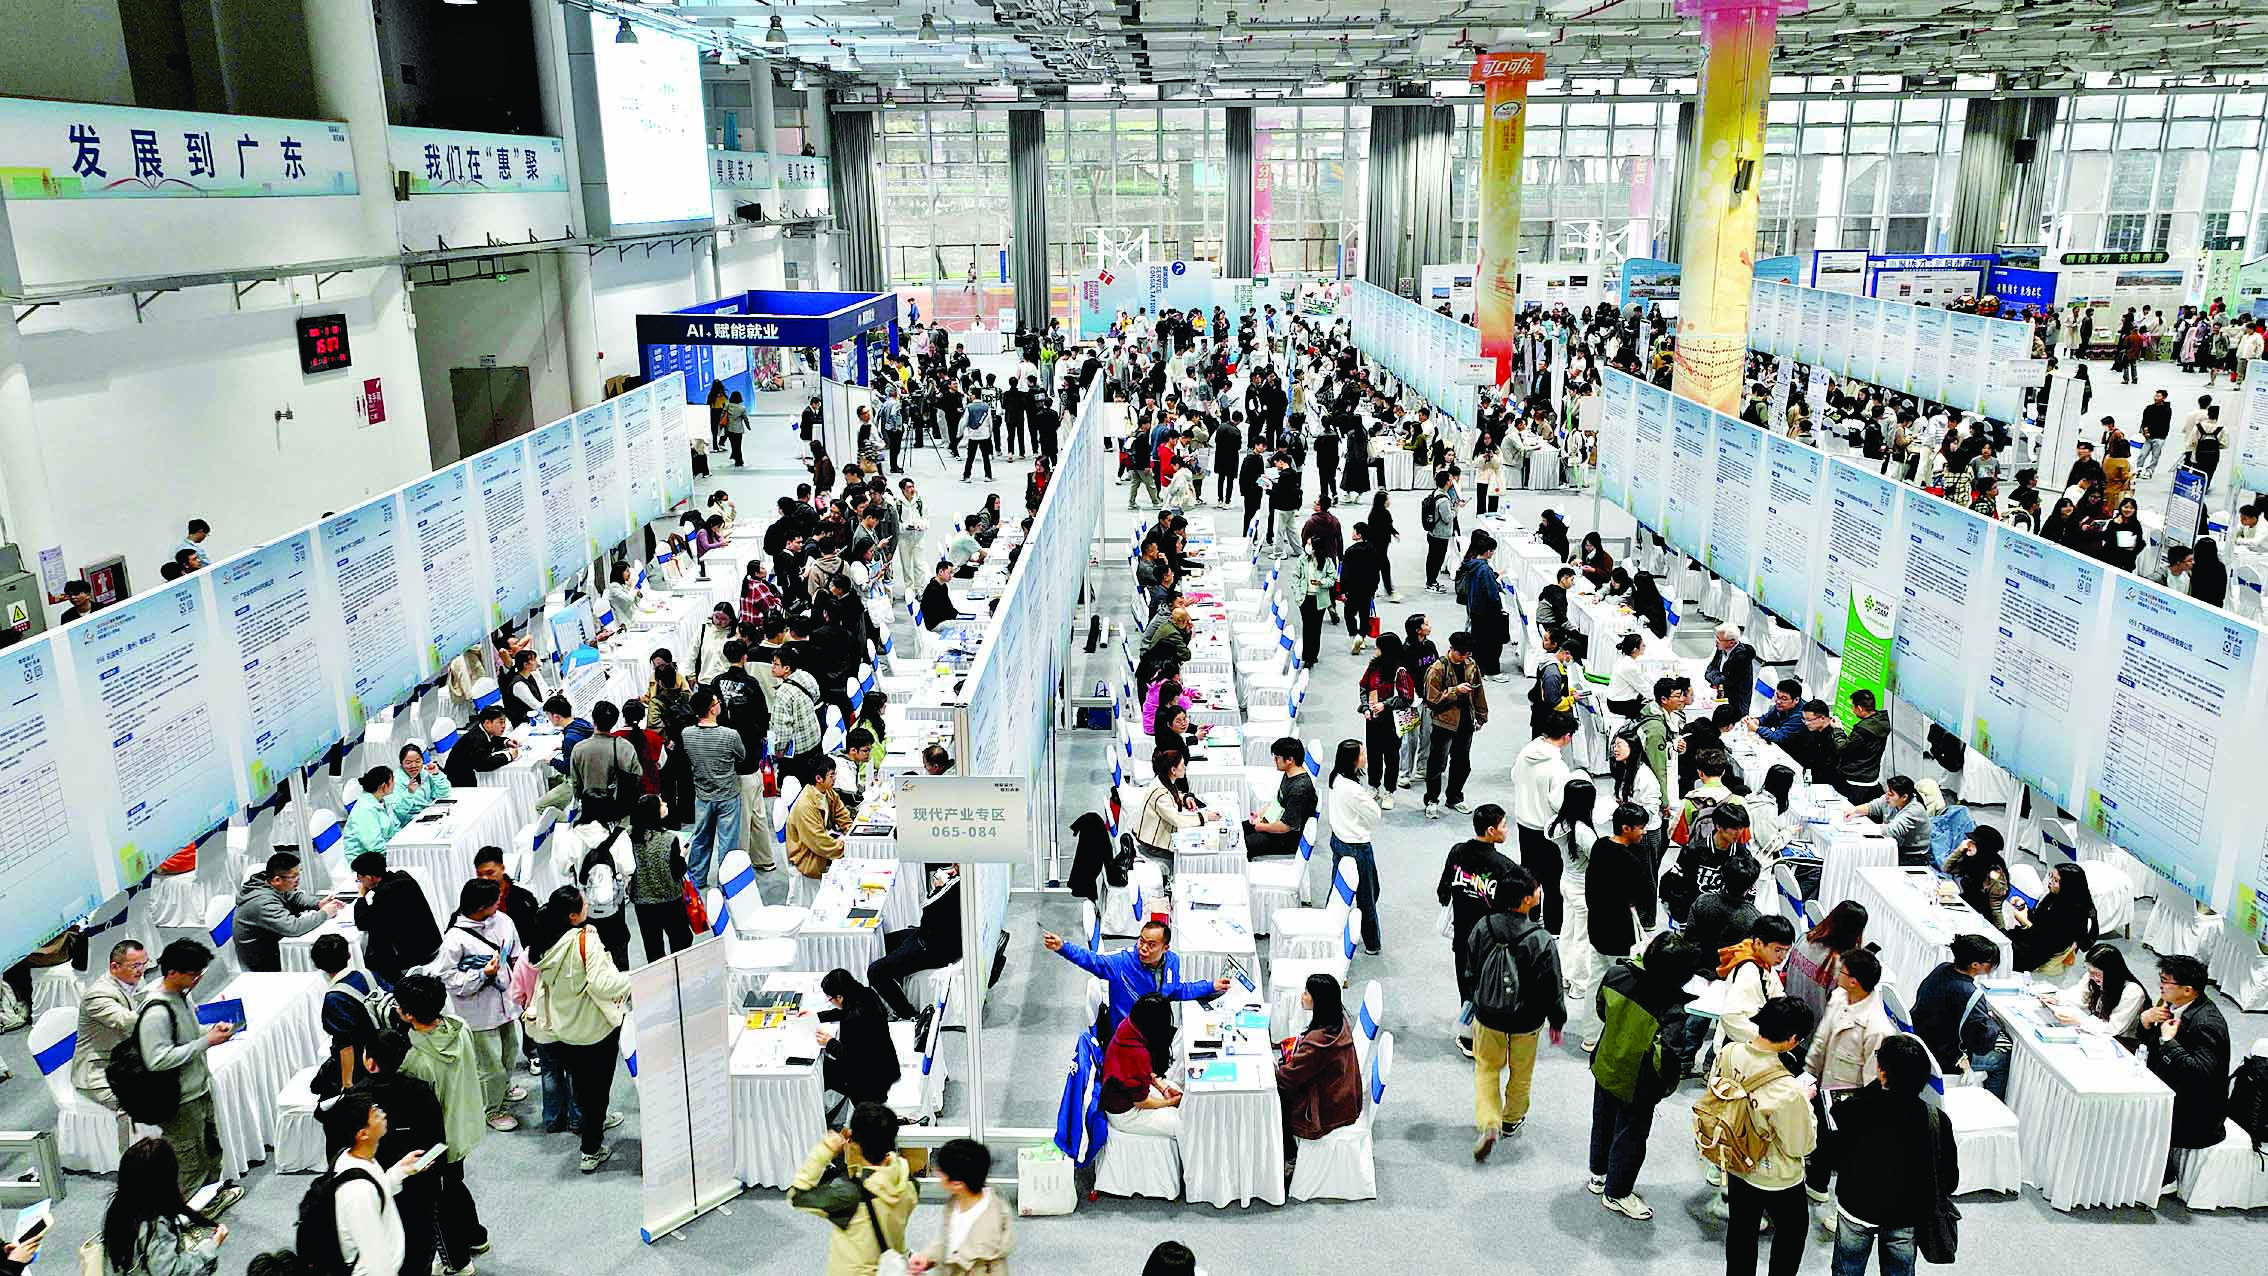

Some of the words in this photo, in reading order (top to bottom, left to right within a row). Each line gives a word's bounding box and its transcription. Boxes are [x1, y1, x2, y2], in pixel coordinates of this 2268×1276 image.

[1482, 57, 1536, 77] 可口可乐
[69, 124, 305, 178] 发展到广东
[913, 807, 1006, 822] 现代产业专区
[931, 826, 997, 838] 065-084
